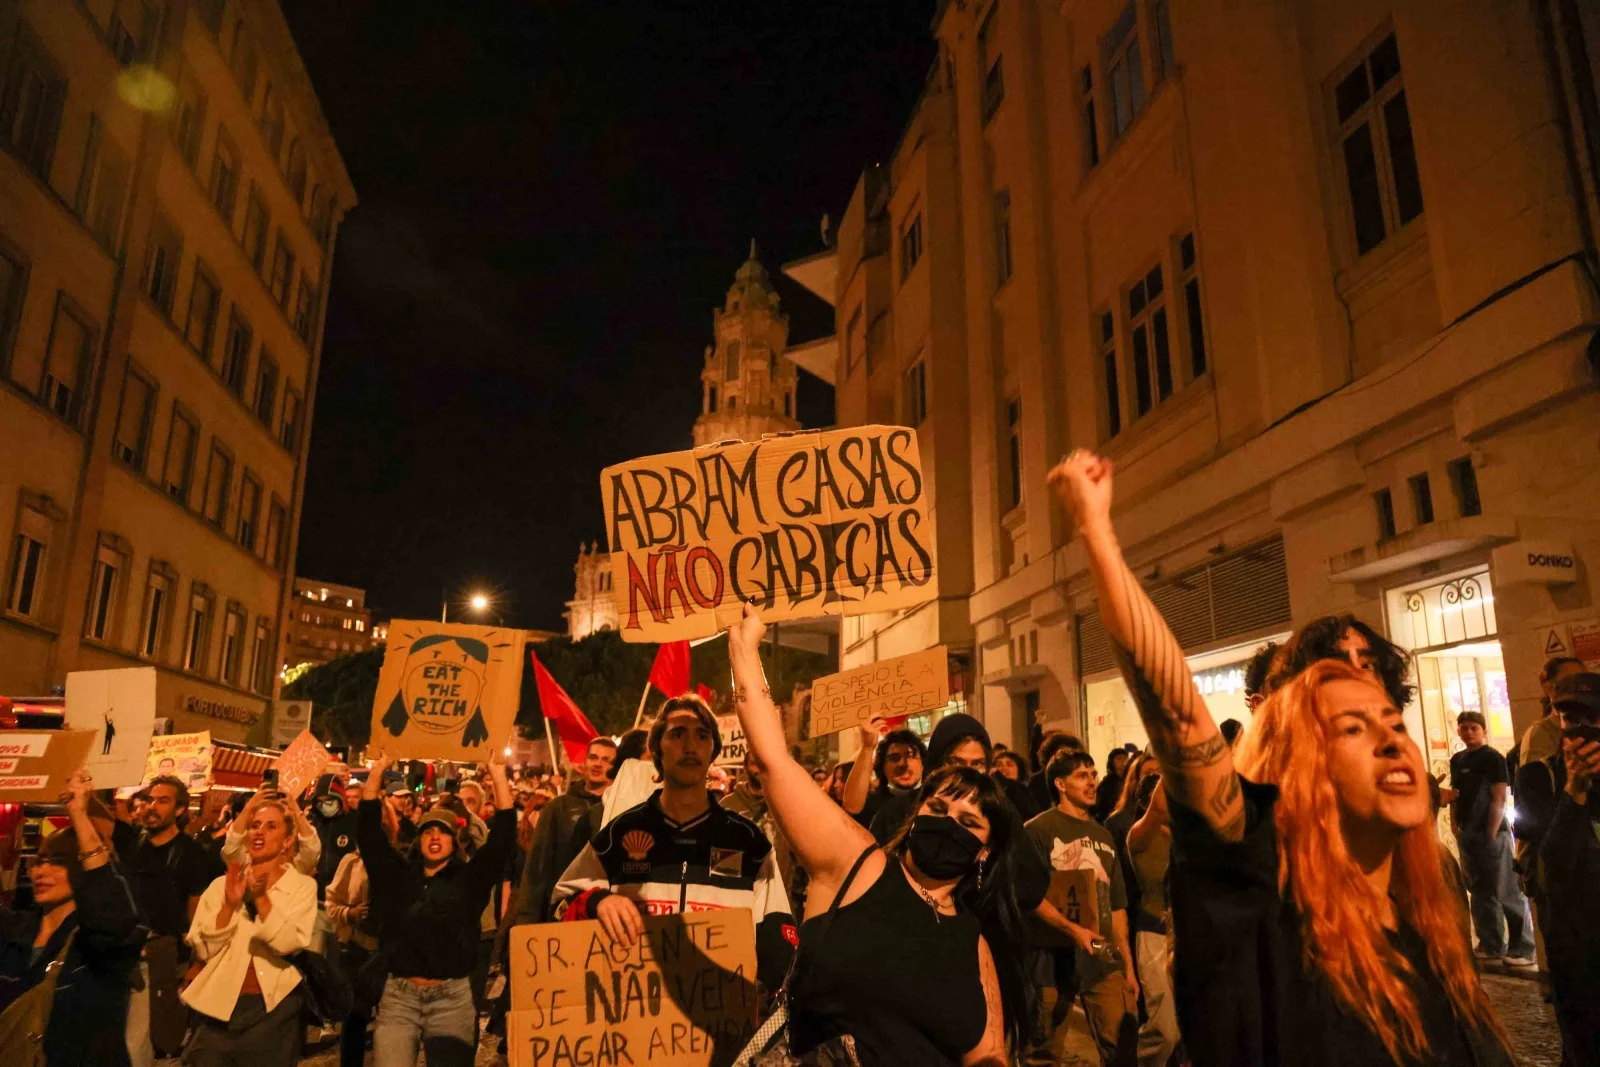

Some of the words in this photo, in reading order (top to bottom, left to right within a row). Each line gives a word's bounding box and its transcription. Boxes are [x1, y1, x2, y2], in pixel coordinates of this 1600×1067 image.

[611, 446, 769, 553] ABRAM
[777, 430, 921, 518] CASAS
[625, 544, 724, 631] NÃO
[729, 508, 935, 610] CABEÇAS
[1528, 553, 1573, 568] DONKO
[423, 666, 462, 681] EAT
[427, 683, 461, 696] THE
[813, 667, 890, 702] DESPEJO
[413, 698, 467, 717] RICH
[813, 679, 913, 714] VIOLÊNCIA
[816, 710, 847, 735] DE
[526, 938, 575, 977] SR.
[532, 988, 568, 1030] SE
[584, 963, 662, 1025] NÃO
[675, 963, 747, 1013] VEM
[529, 1031, 634, 1067] PAGAR
